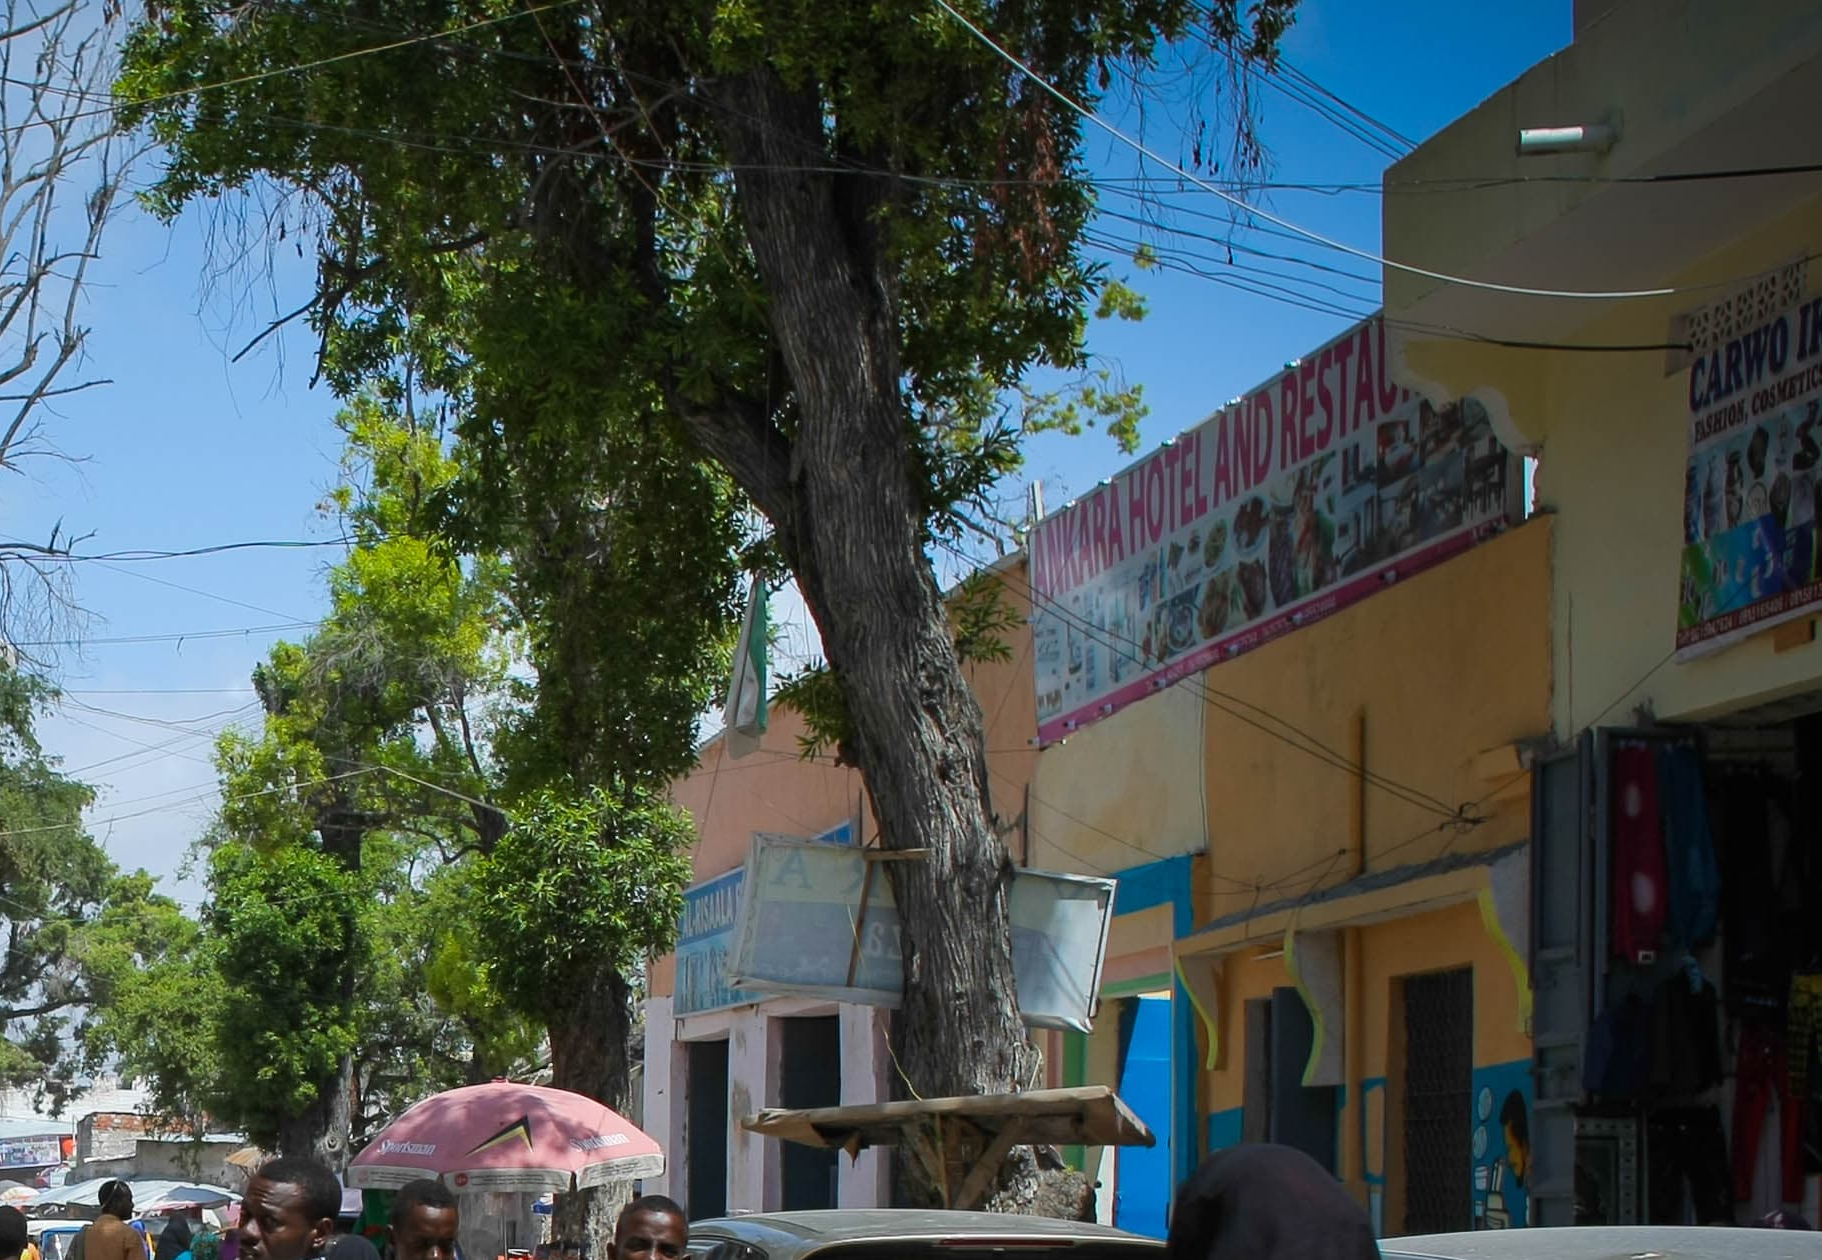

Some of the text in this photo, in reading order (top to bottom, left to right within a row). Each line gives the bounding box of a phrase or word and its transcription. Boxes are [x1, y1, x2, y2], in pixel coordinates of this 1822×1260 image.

[1689, 315, 1788, 414] CARWO
[1694, 398, 1748, 443] FASHION,
[1033, 314, 1409, 600] ANKARA HOTEL AND RESTAU
[377, 1139, 436, 1156] Sportsman
[570, 1133, 630, 1153] Sportsman
